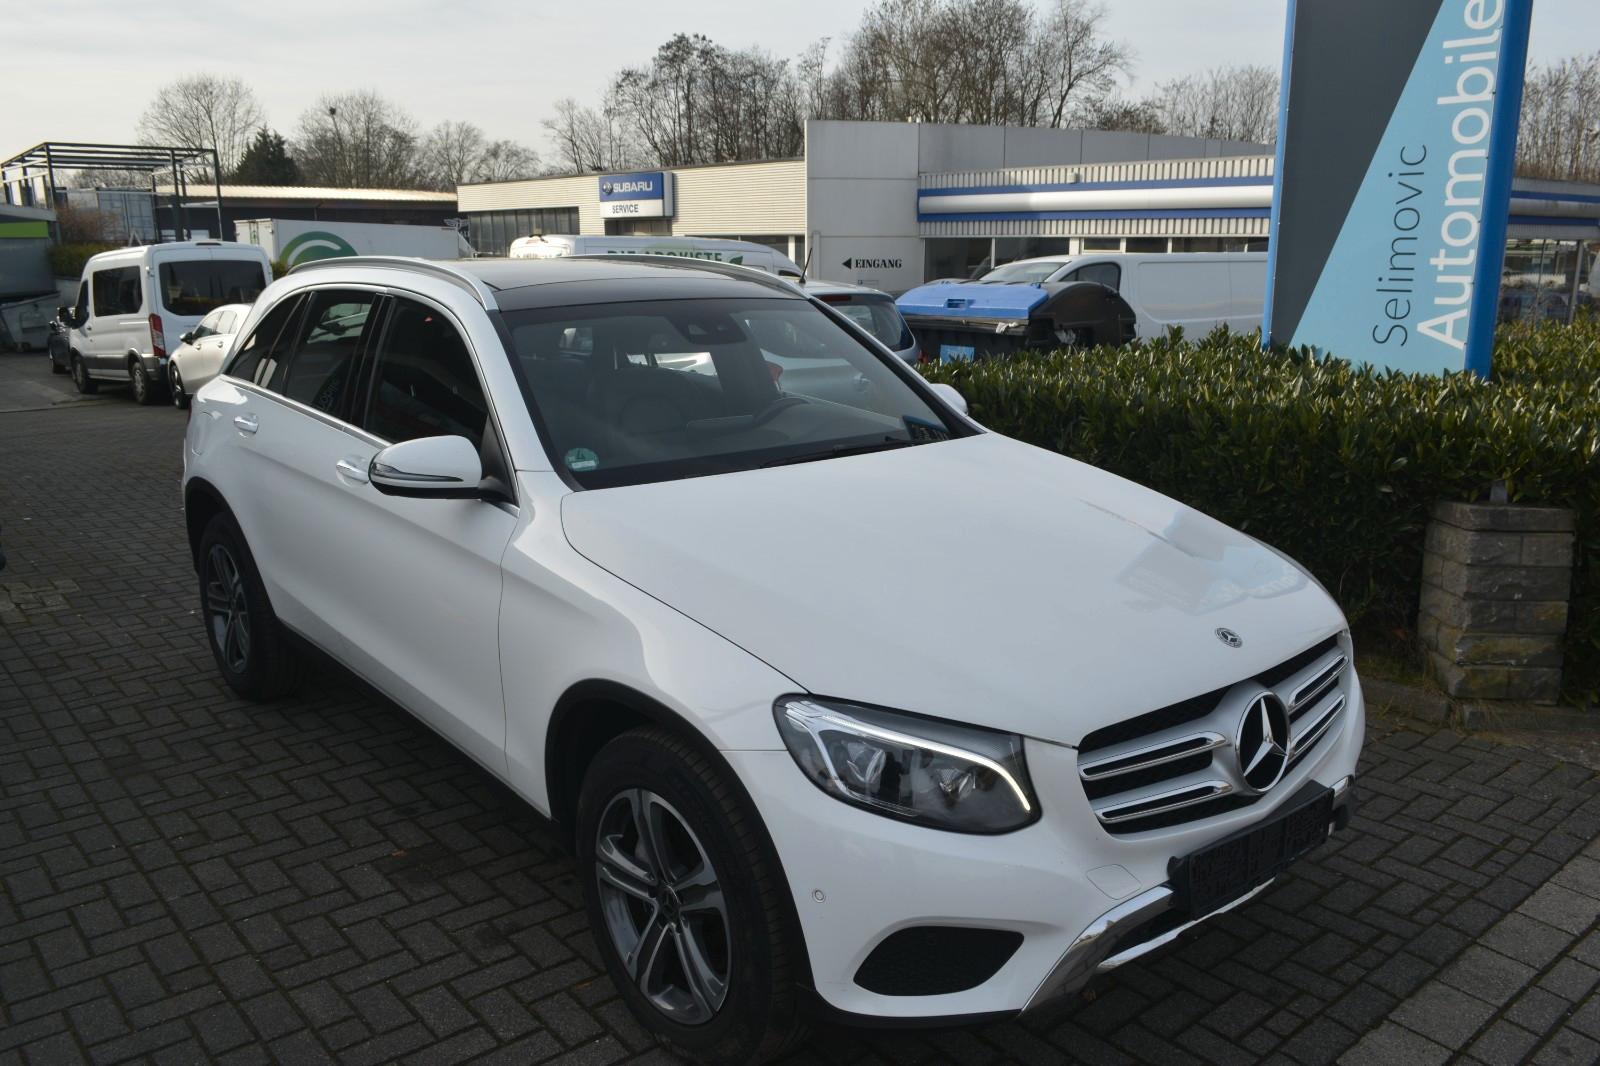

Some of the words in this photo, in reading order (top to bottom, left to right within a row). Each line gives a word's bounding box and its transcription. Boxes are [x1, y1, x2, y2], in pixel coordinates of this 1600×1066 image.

[613, 181, 653, 193] SUBARU
[612, 203, 639, 214] SERVICE
[1372, 144, 1427, 347] Selimovic
[855, 258, 902, 268] EINGANG
